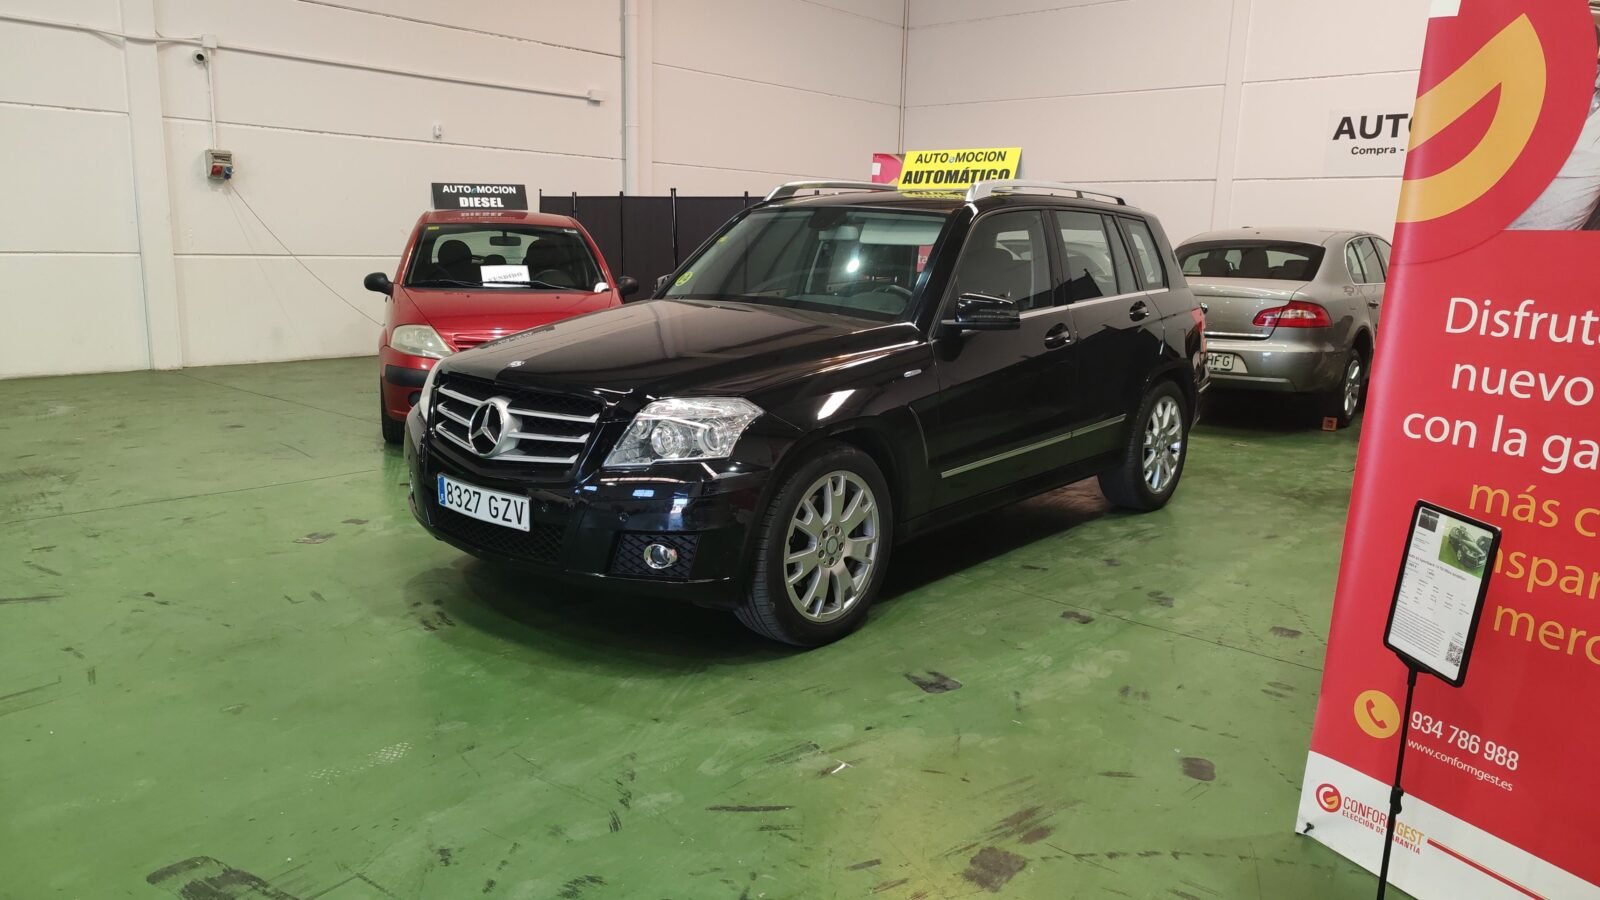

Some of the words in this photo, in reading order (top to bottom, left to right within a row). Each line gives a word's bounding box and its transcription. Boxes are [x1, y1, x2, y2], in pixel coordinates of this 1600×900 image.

[1332, 113, 1413, 141] AUT
[1351, 146, 1396, 155] Compra
[902, 167, 1011, 184] AUTOMÁTICO
[459, 197, 504, 208] DIESEL
[1445, 297, 1600, 346] Disfrut
[1452, 363, 1594, 406] nuevo
[1403, 413, 1477, 448] con
[1491, 414, 1527, 457] la
[446, 482, 481, 514] 8327
[488, 495, 524, 525] GZV
[1469, 484, 1560, 528] más
[1411, 711, 1443, 739] 934
[1448, 725, 1480, 754] 786
[1484, 741, 1519, 771] 988
[1407, 739, 1513, 792] www.conformgest.es
[1343, 796, 1424, 845] CONFORGEST
